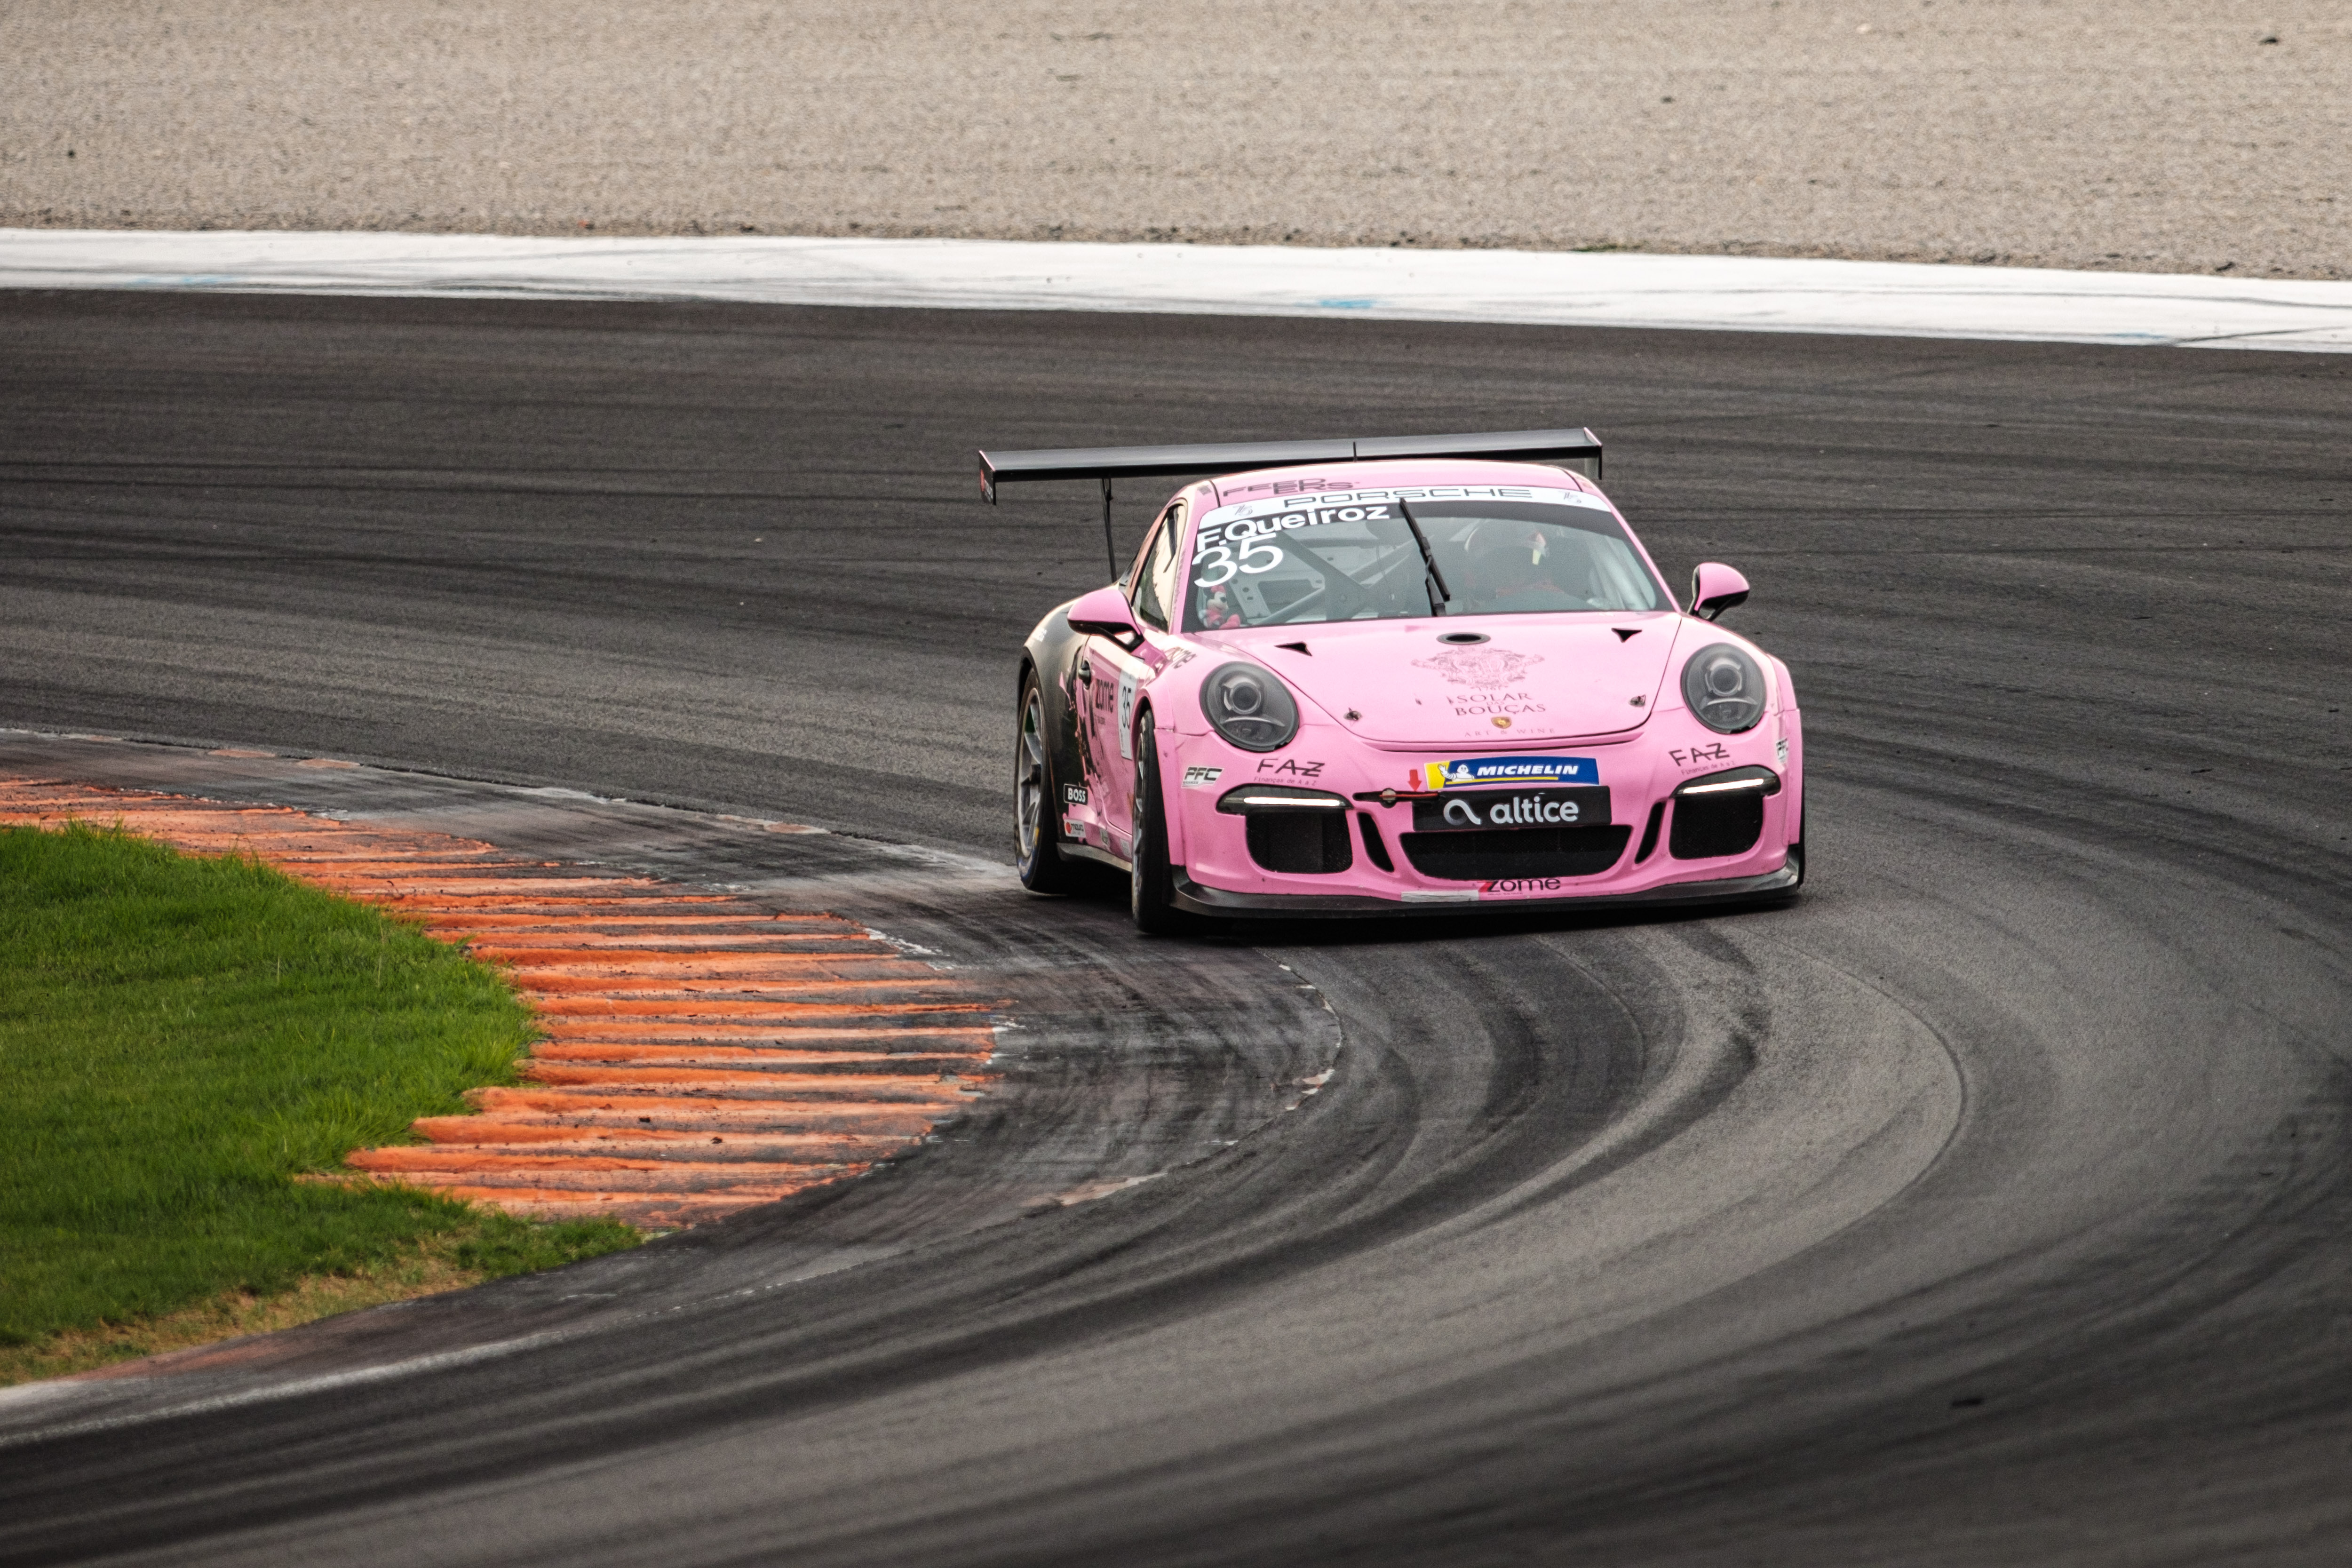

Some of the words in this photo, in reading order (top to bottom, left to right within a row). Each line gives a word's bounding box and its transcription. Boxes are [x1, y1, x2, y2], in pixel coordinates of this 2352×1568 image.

[1284, 488, 1533, 508] PORSCHE
[1197, 506, 1390, 552] F.Queiroz
[1192, 532, 1283, 588] 35
[1122, 685, 1132, 729] 35
[1456, 693, 1533, 703] SOLAR
[1454, 704, 1546, 716] BOUÇAS
[1669, 742, 1730, 766] FAZ
[1184, 767, 1223, 781] PFC
[1256, 758, 1325, 777] FAZ
[1477, 764, 1579, 776] MICHELIN
[1068, 787, 1086, 803] BOSS
[1490, 796, 1579, 824] altice
[1480, 878, 1561, 892] zome
